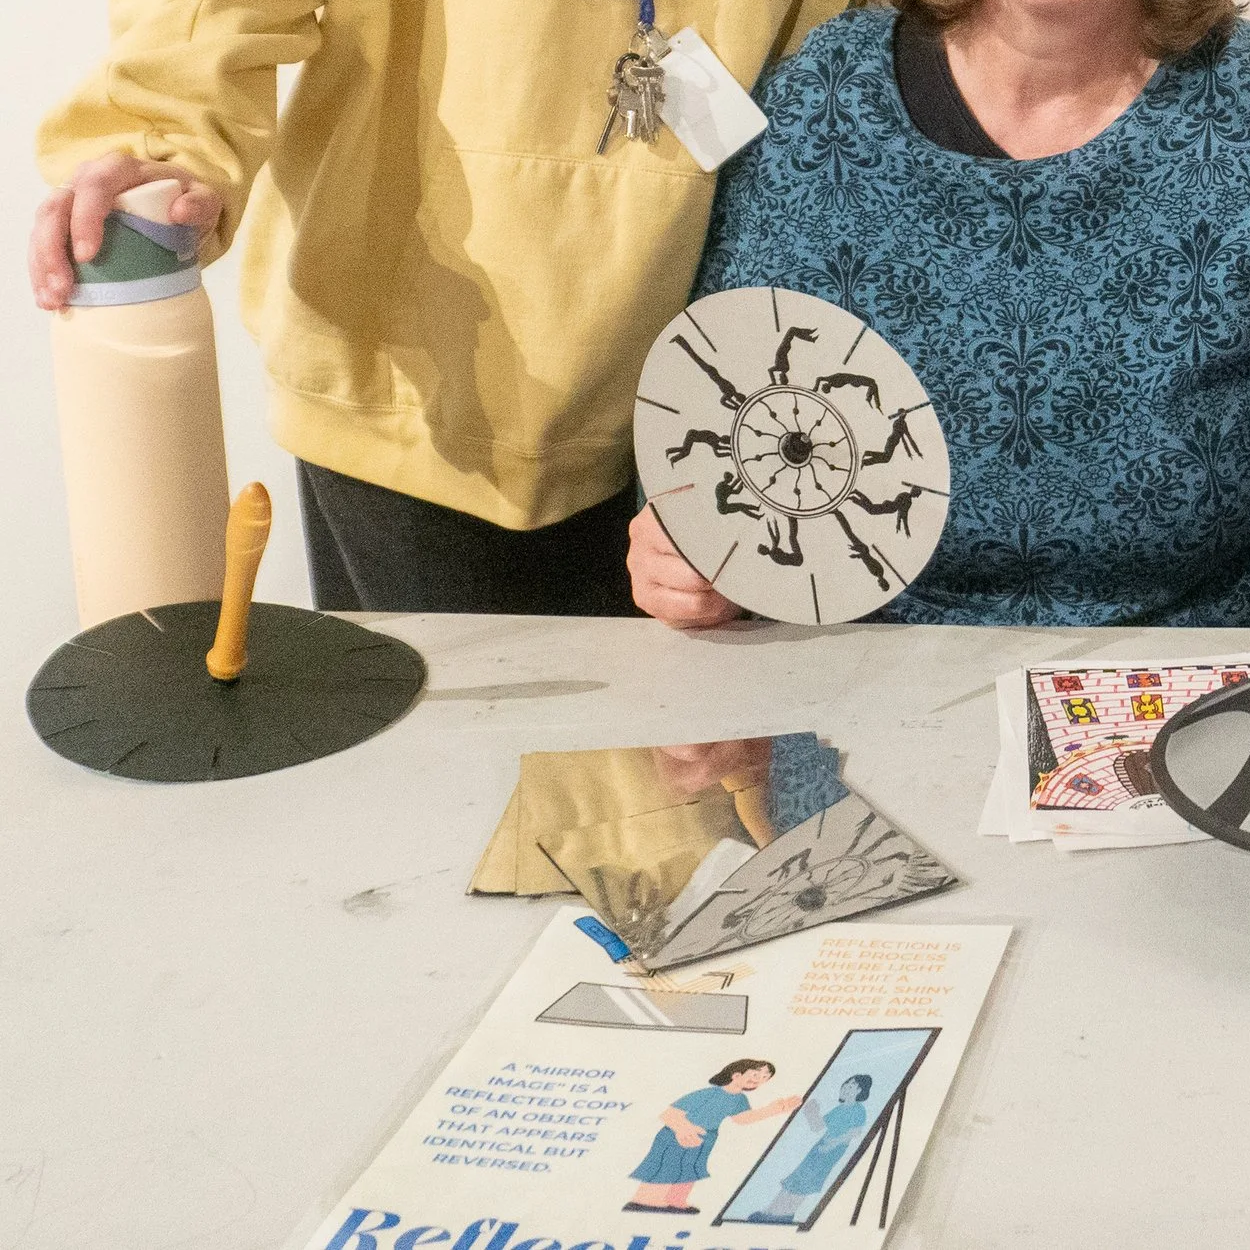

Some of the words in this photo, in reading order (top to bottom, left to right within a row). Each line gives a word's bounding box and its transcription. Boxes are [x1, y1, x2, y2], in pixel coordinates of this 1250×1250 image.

[822, 938, 940, 951] REFLECTION
[944, 942, 961, 951] IS
[818, 949, 851, 959] THE
[859, 951, 948, 962] PROCESS
[811, 961, 883, 972] WHERE
[888, 963, 945, 973] LIGHT
[804, 971, 854, 982] RAYS
[860, 973, 889, 982] HIT
[896, 974, 909, 983] A
[893, 985, 954, 995] SHINY
[792, 995, 882, 1005] SURFACE
[888, 996, 933, 1006] AND
[501, 1062, 517, 1072] A
[525, 1064, 616, 1080] "MIRROR
[488, 1076, 566, 1091] IMAGE"
[570, 1083, 588, 1093] IS
[593, 1084, 608, 1094] A
[444, 1086, 567, 1108] REFLECTED
[572, 1099, 633, 1112] COPY
[450, 1104, 481, 1116] OF
[483, 1108, 517, 1120] AN
[522, 1112, 607, 1127] OBJECT
[436, 1118, 493, 1134] THAT
[496, 1125, 598, 1143] APPEARS
[422, 1134, 536, 1155] IDENTICAL
[543, 1146, 590, 1159] BUT
[432, 1152, 552, 1173] REVERSED.
